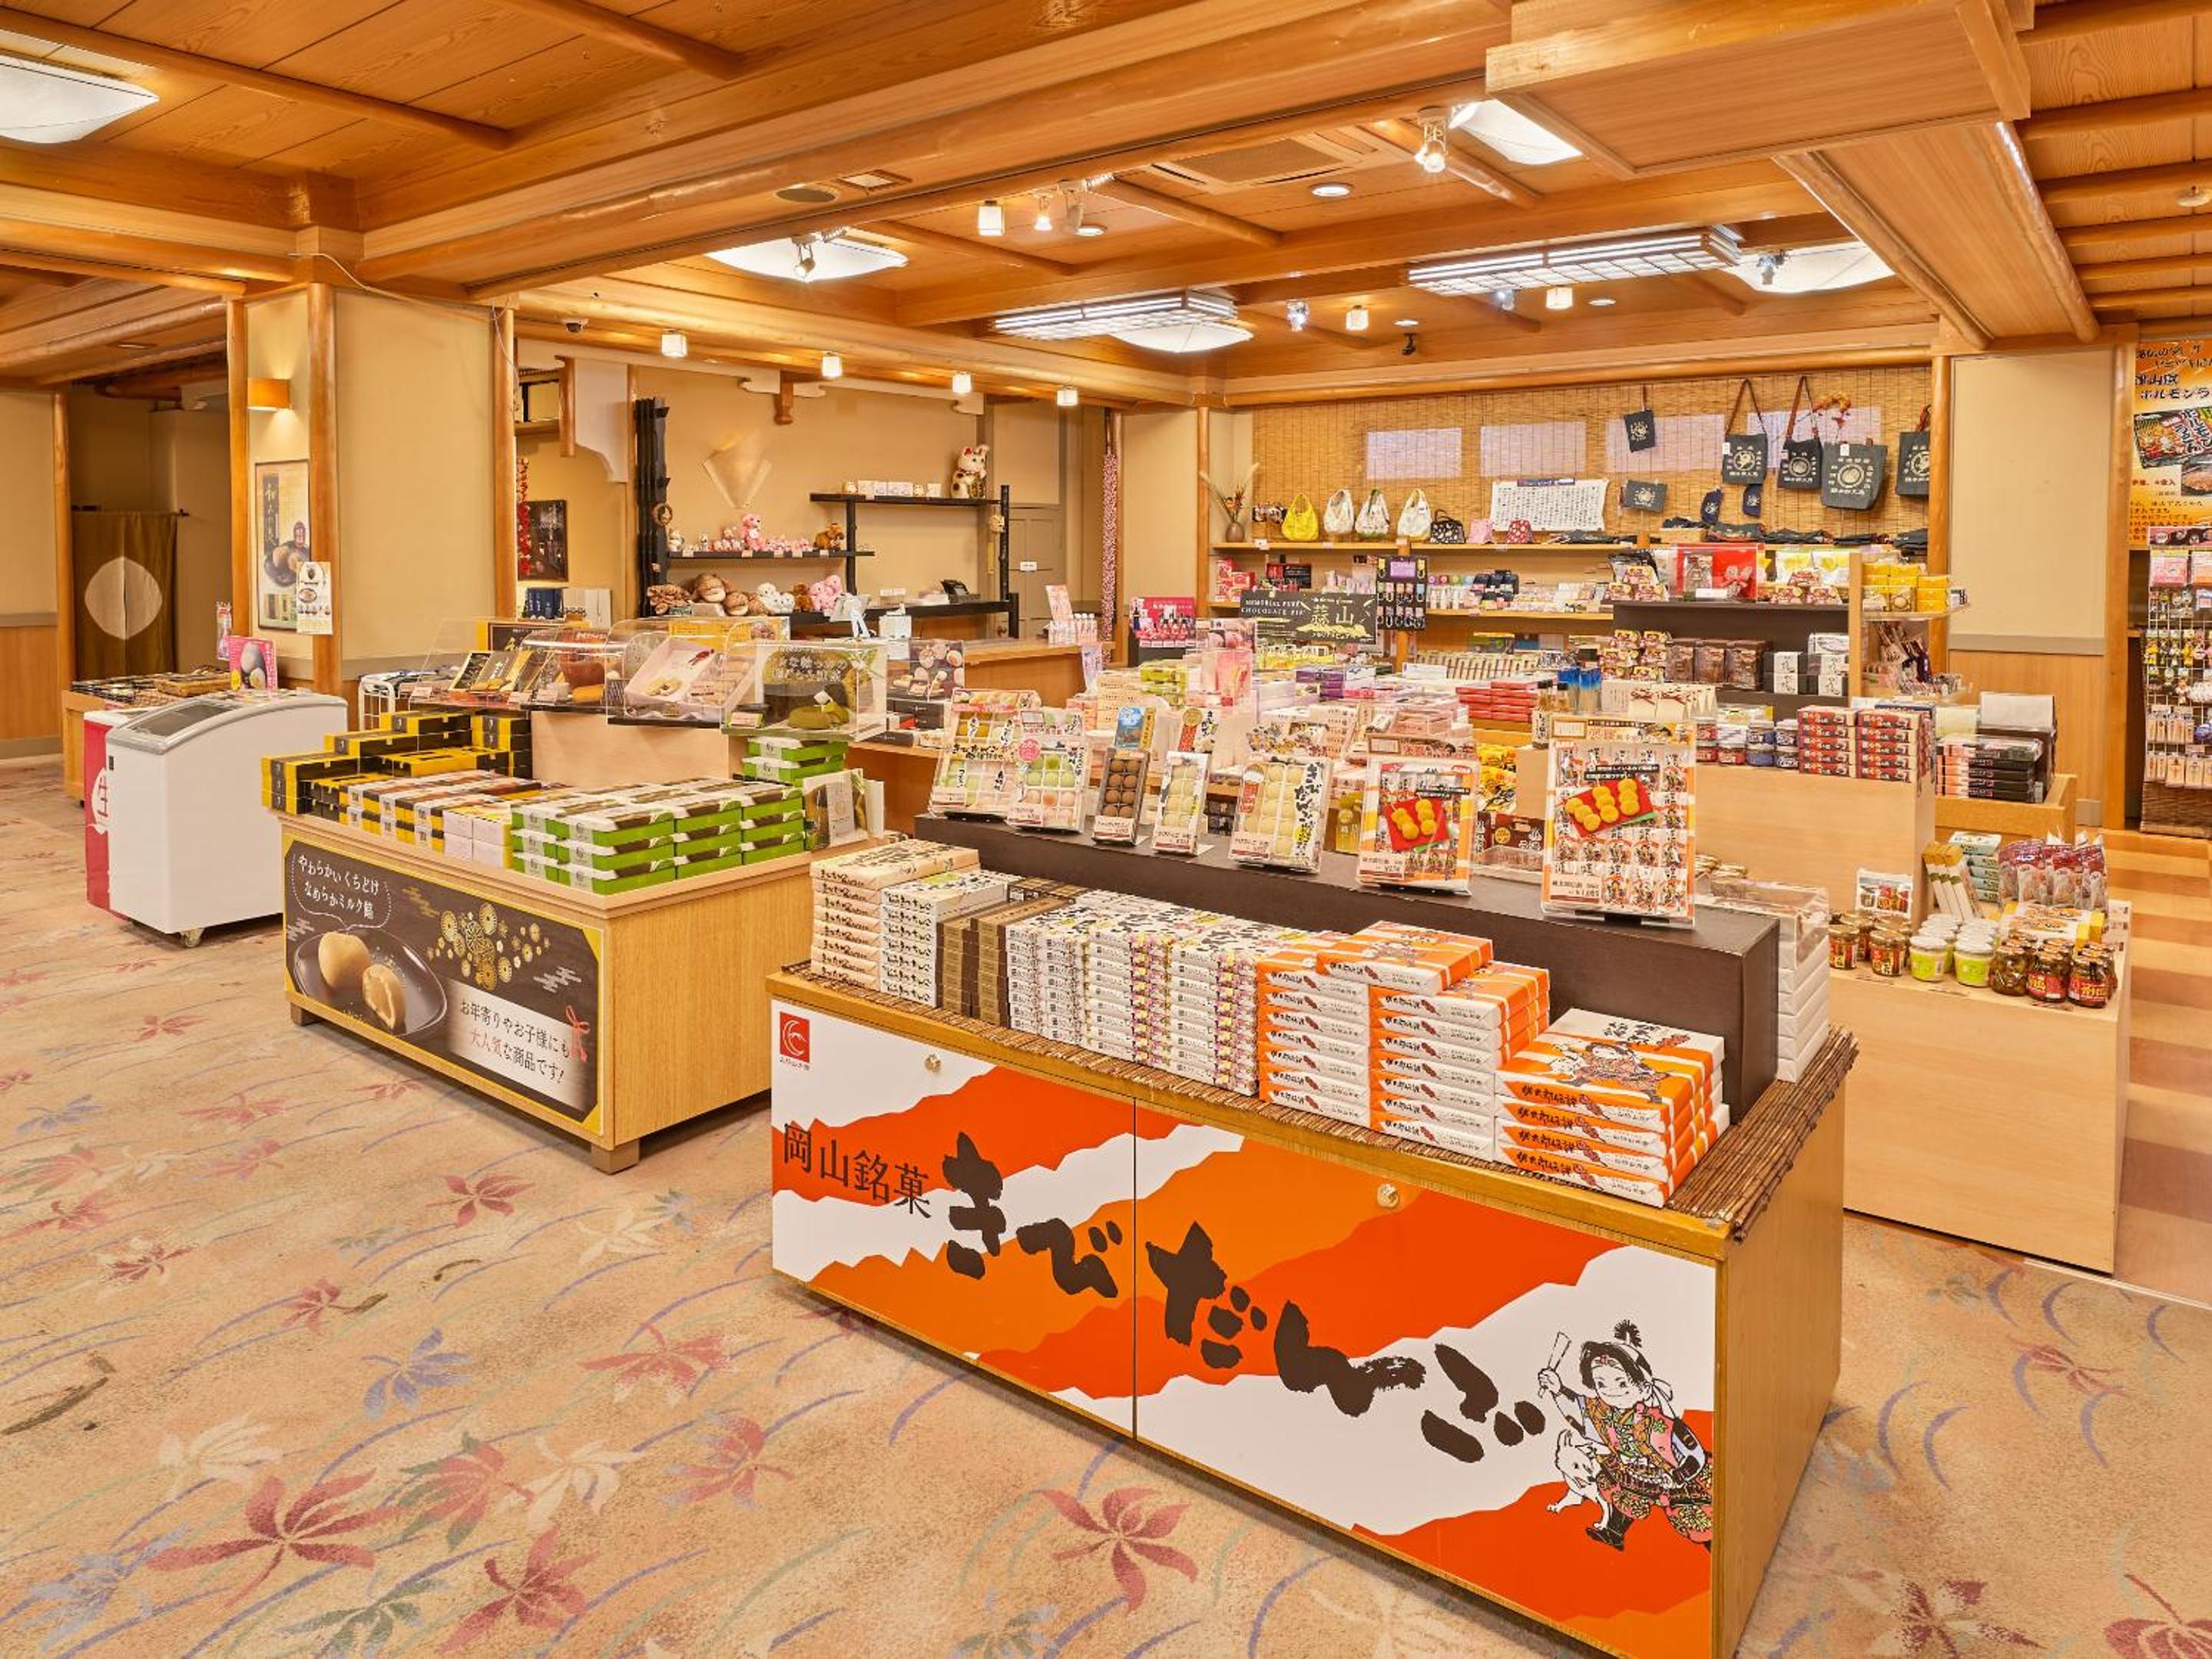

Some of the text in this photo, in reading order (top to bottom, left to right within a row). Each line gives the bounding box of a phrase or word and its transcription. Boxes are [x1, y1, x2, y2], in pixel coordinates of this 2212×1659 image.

[1310, 604, 1354, 626] 蒜山
[298, 854, 379, 896] やわらかいくちどけ
[461, 998, 569, 1058] お年寄りやお子様にも
[783, 1124, 931, 1219] 岡山銘菓
[942, 1131, 1545, 1463] きびだんご
